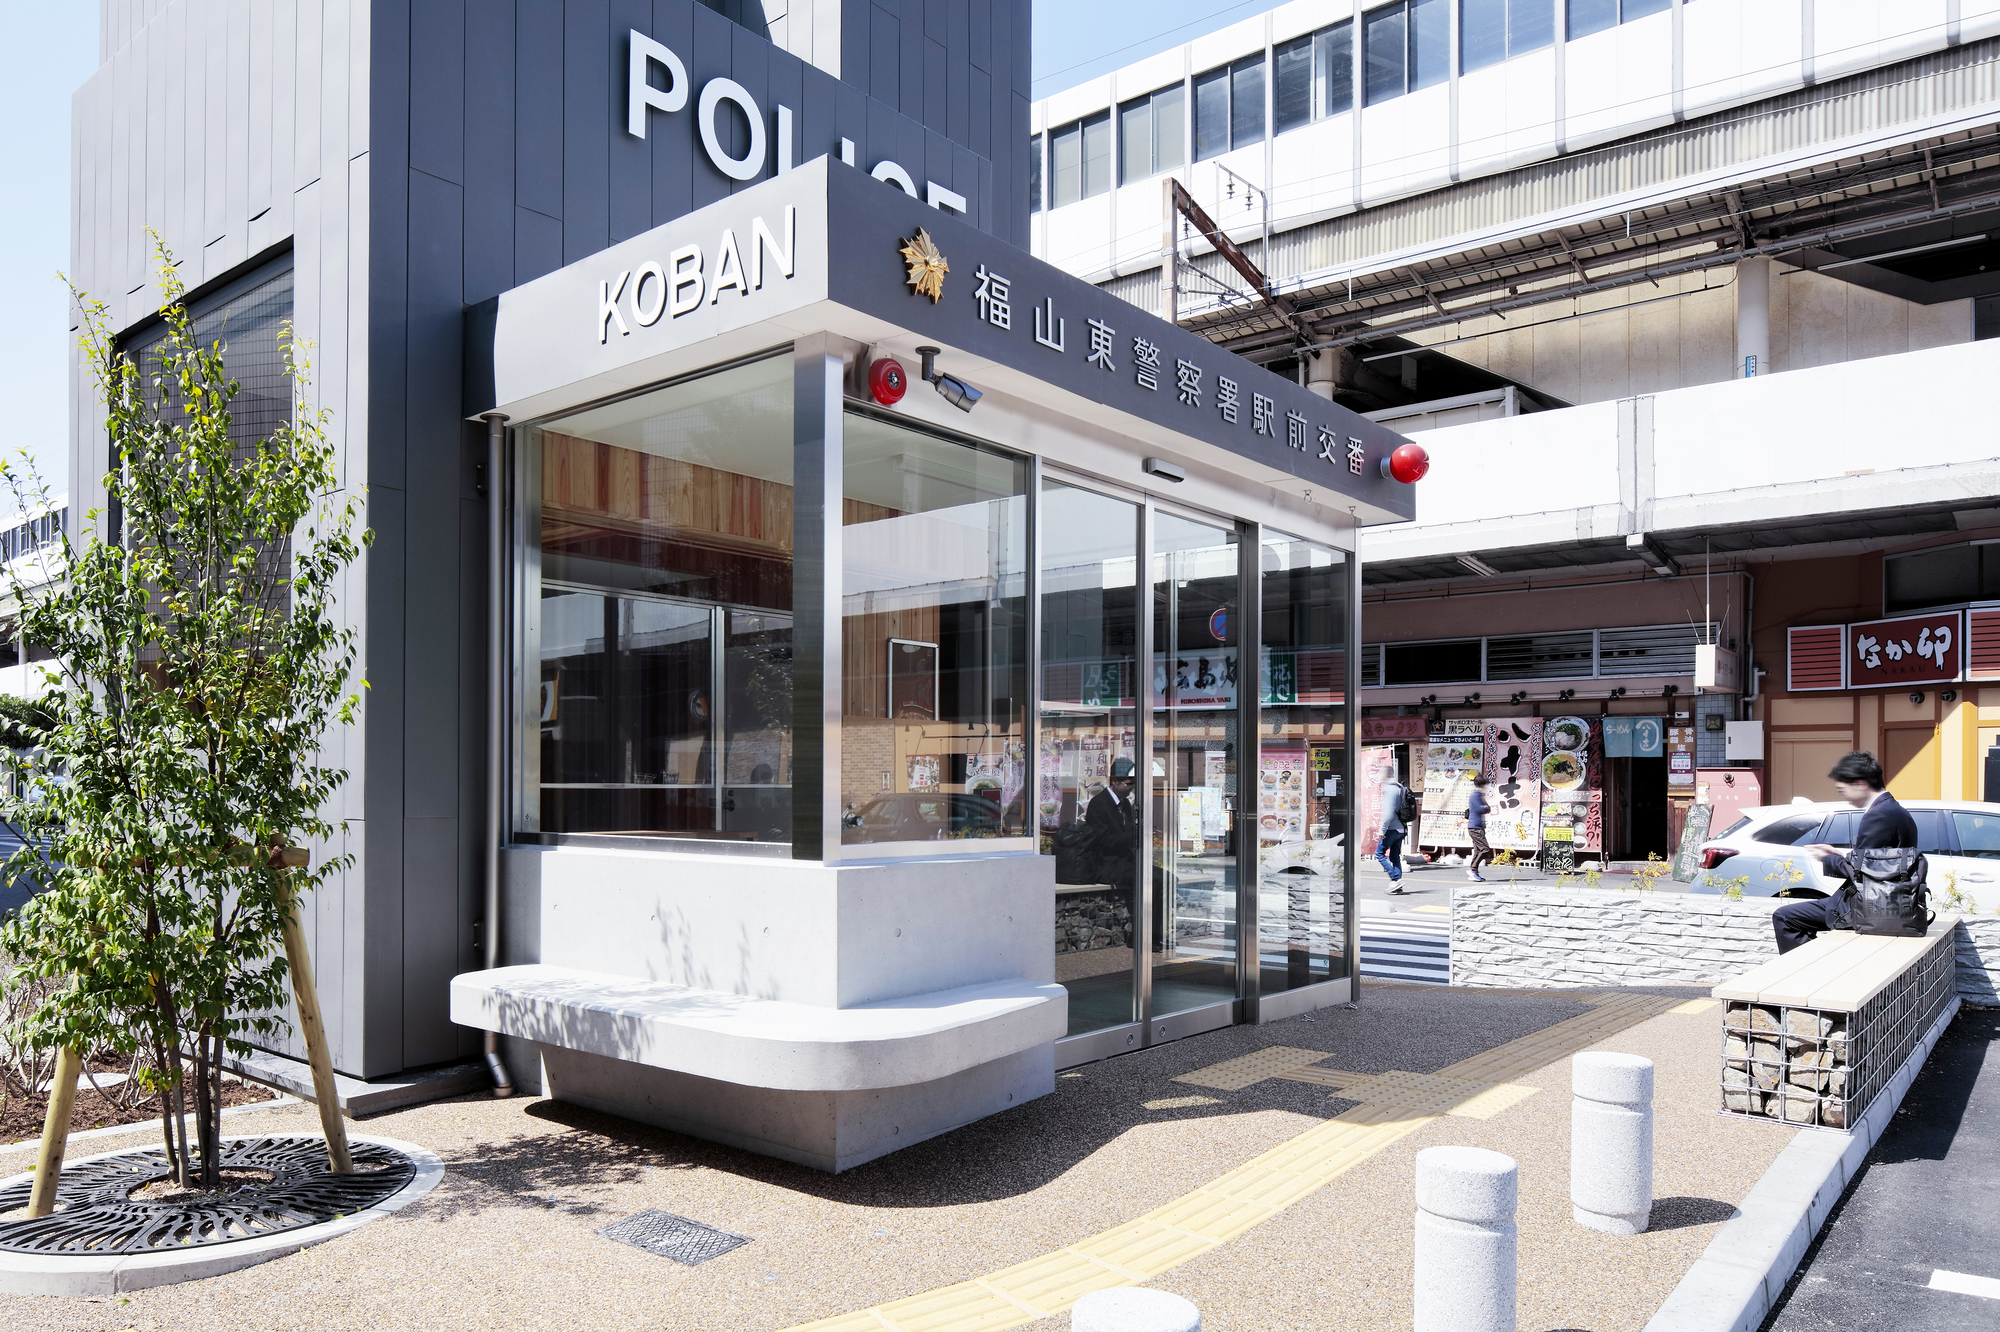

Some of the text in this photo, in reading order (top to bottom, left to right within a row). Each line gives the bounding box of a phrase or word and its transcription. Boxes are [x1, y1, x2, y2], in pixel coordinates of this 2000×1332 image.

[599, 204, 796, 344] KOBAN
[974, 264, 1365, 476] 福山東警察署駅前交番
[1856, 625, 1952, 671] なか卯
[1881, 664, 1926, 675] NAKAU
[1180, 697, 1216, 705] HIROSHIMA
[1447, 725, 1482, 734] 黒ラベル
[1605, 724, 1631, 735] らーめん
[1096, 752, 1108, 778] 和風
